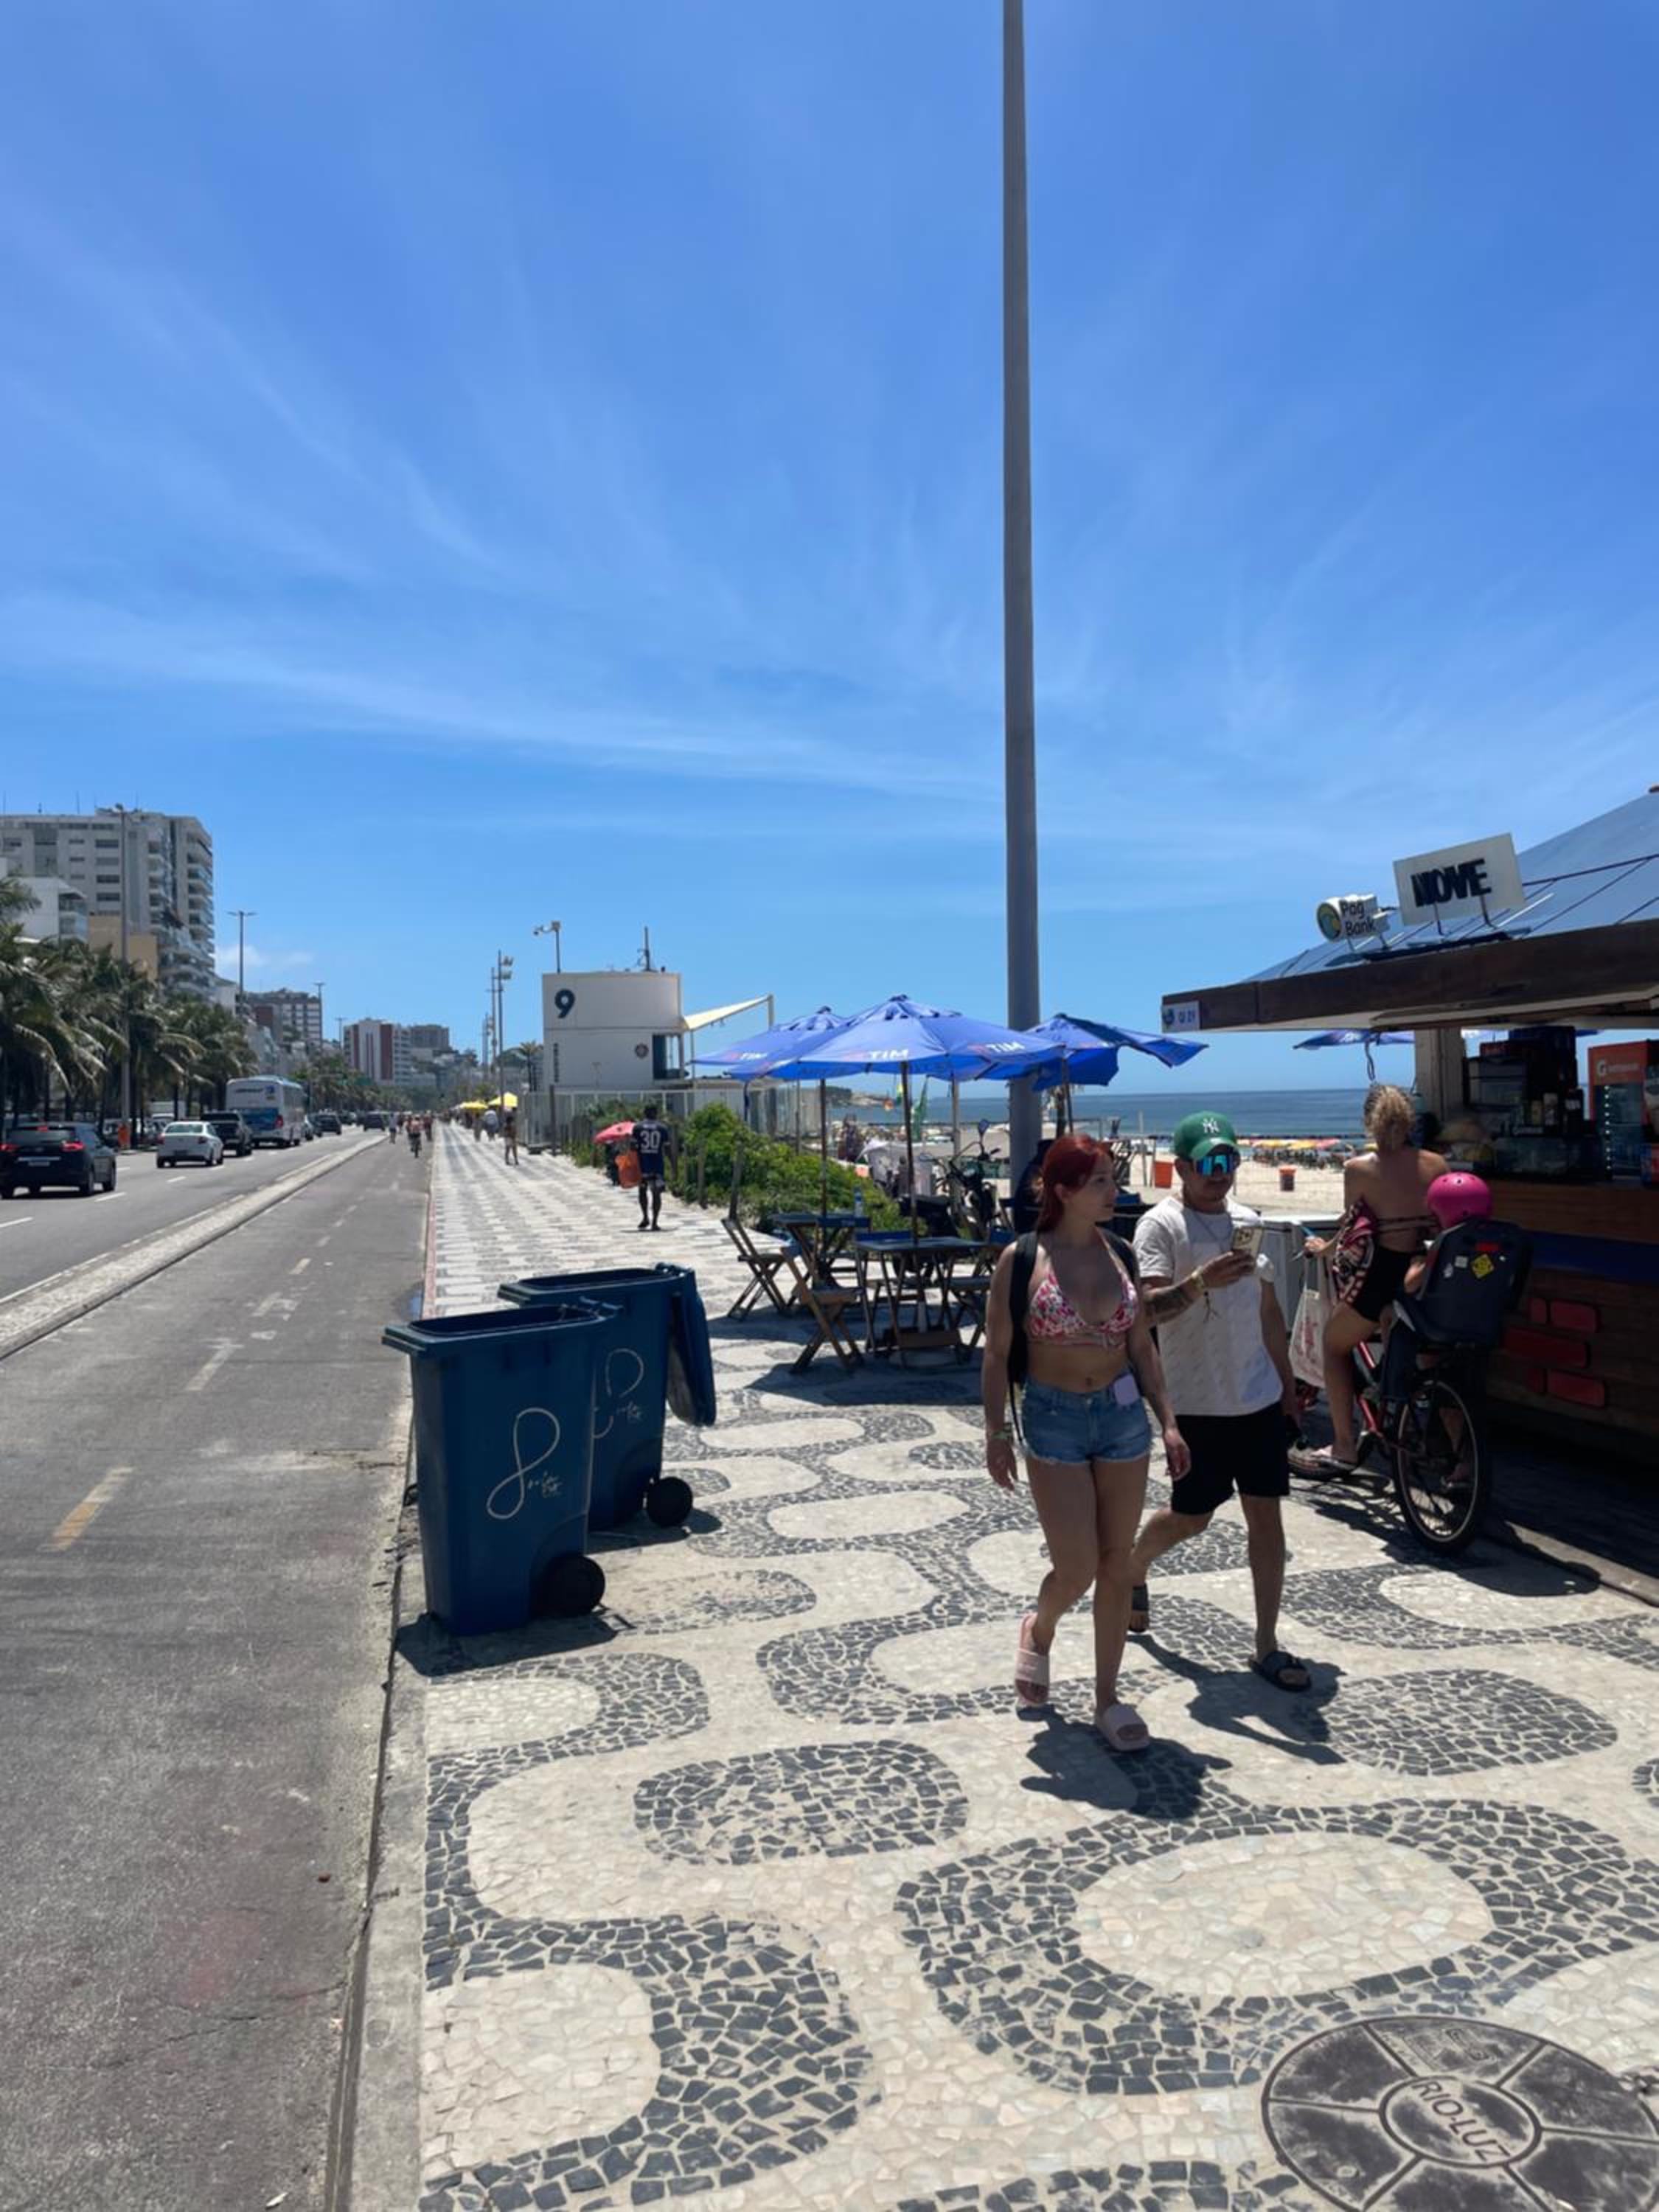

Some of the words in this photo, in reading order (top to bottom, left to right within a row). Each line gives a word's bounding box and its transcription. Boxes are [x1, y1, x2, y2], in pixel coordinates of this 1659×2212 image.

[1411, 858, 1492, 908] NOVE
[1340, 900, 1365, 919] Pag
[1345, 919, 1375, 936] Bank
[554, 989, 576, 1019] 9
[869, 1049, 908, 1060] TIM
[985, 1041, 1026, 1054] TIM
[1203, 1117, 1220, 1133] NY
[640, 1130, 661, 1150] 30
